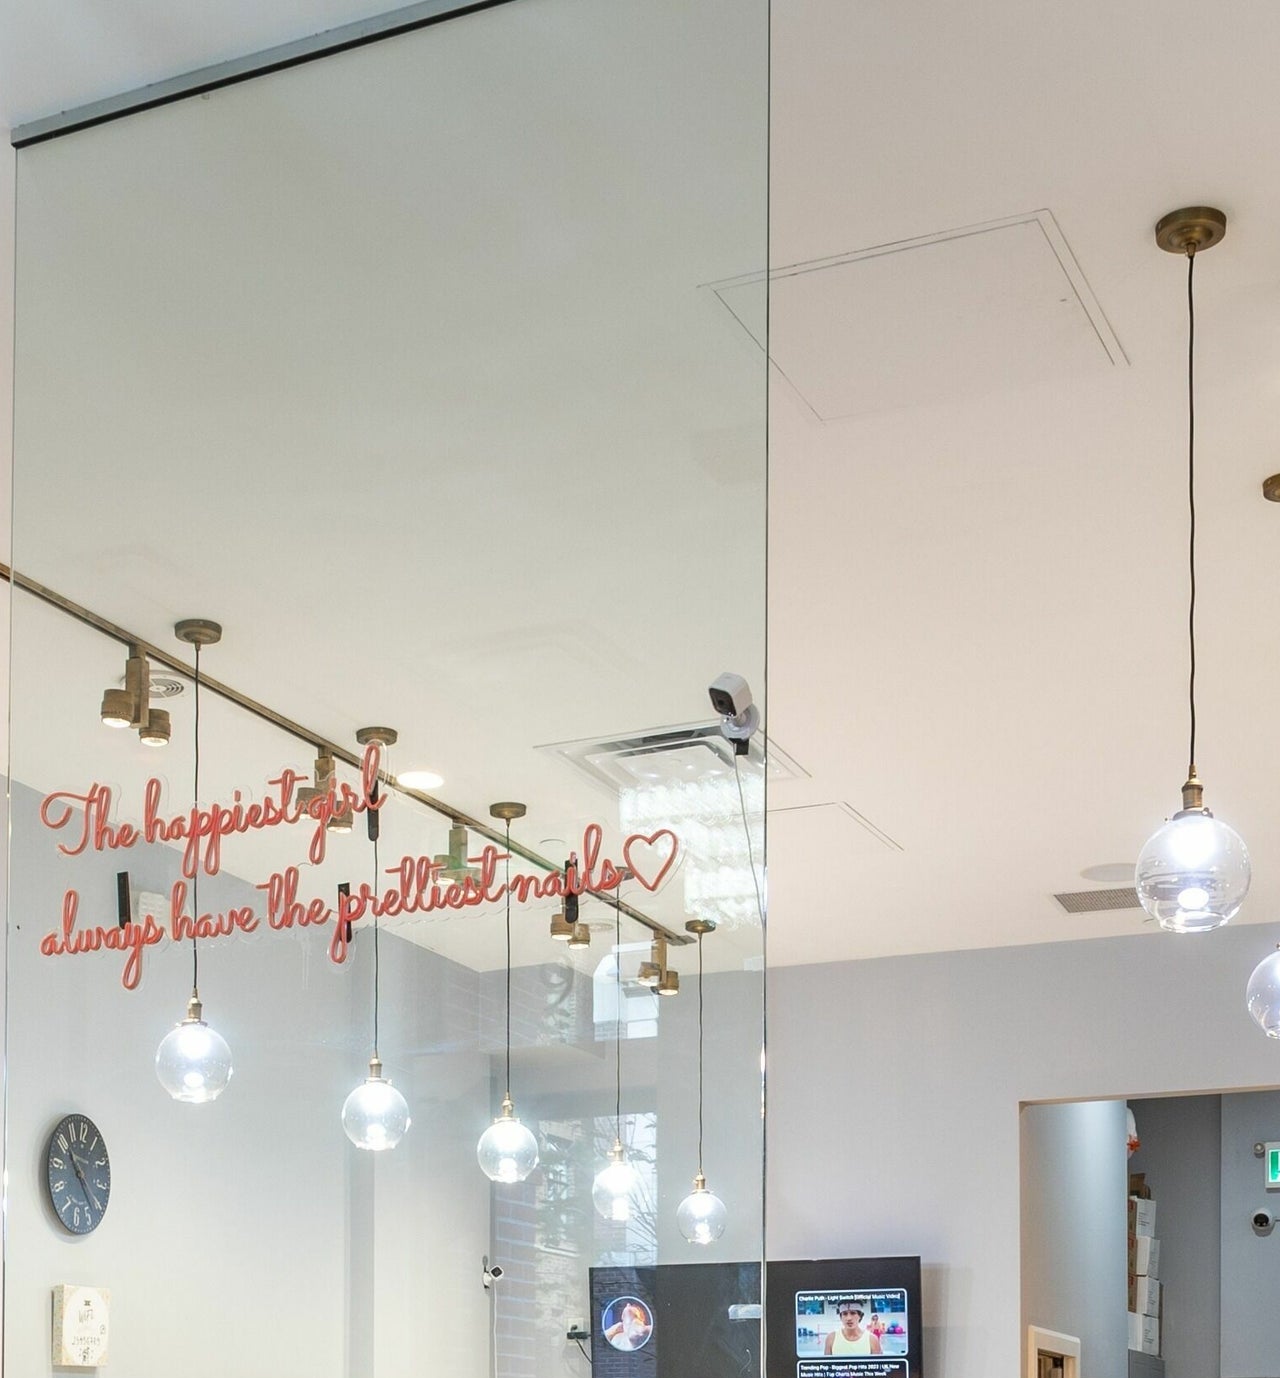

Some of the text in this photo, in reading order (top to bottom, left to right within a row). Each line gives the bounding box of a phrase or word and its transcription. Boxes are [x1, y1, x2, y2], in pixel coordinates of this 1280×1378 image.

[40, 743, 388, 878] The happiest girl
[40, 823, 630, 990] always have the prettiest nails
[68, 1122, 76, 1143] 11
[80, 1122, 88, 1143] 12
[57, 1134, 69, 1154] 10
[90, 1136, 98, 1151] 1
[52, 1157, 64, 1169] 9
[95, 1157, 106, 1169] 2
[54, 1181, 65, 1192] 8
[96, 1179, 107, 1190] 3
[61, 1195, 72, 1212] 7
[73, 1207, 80, 1226] 6
[84, 1206, 92, 1226] 5
